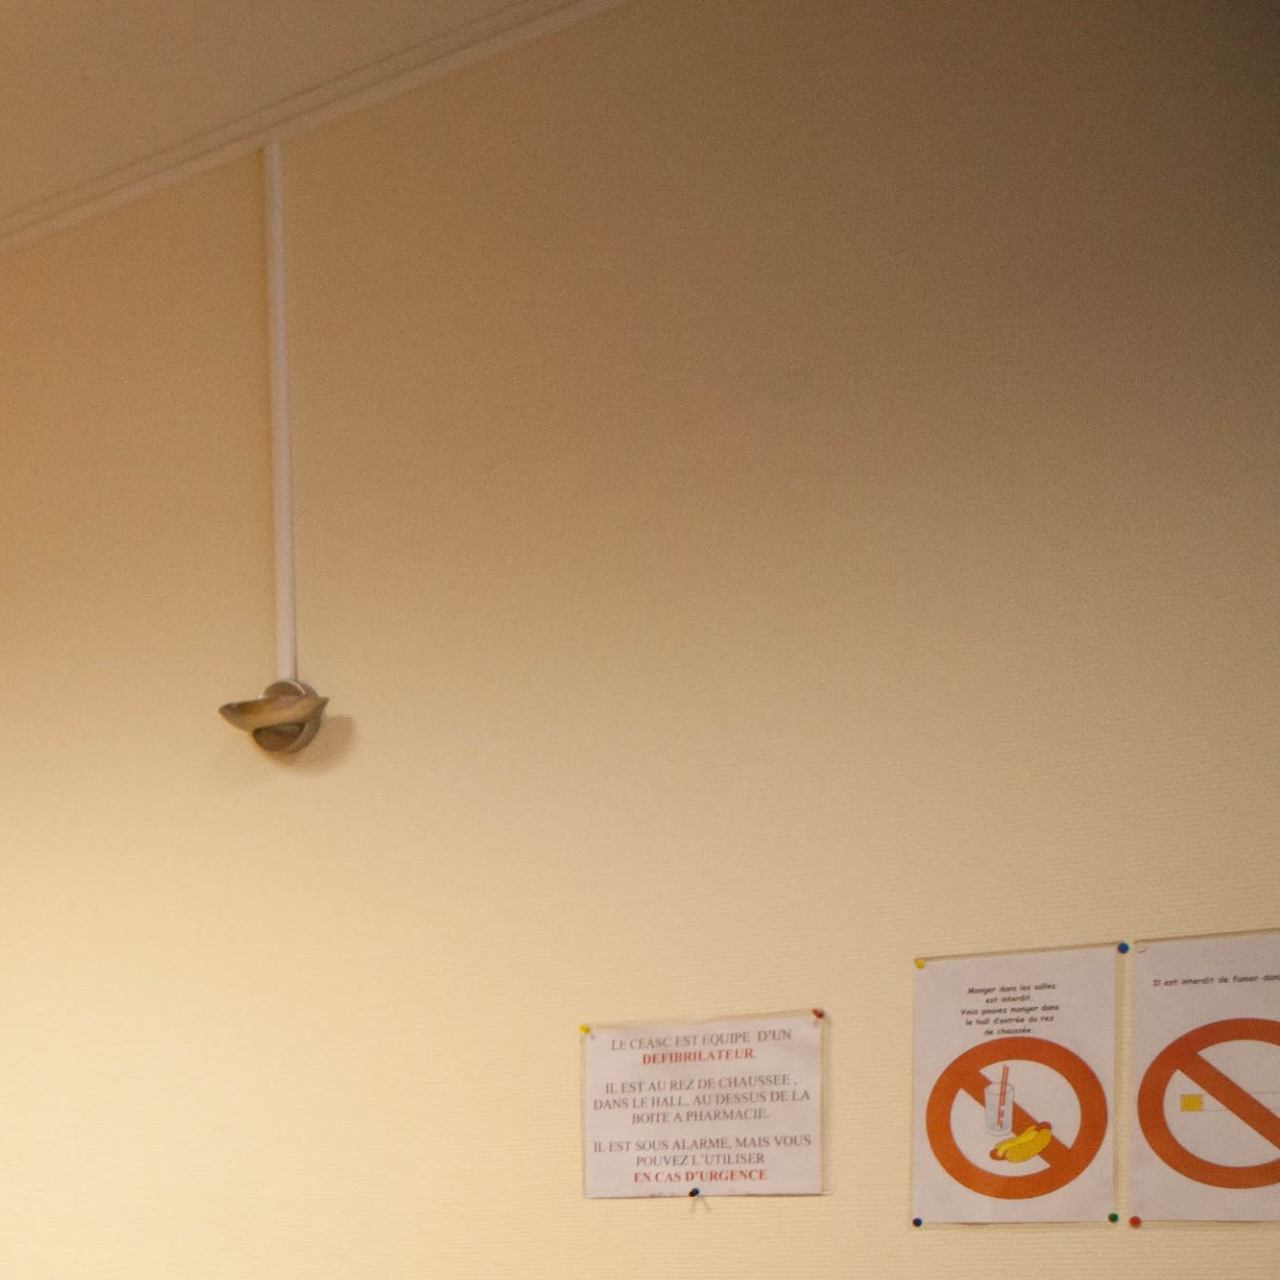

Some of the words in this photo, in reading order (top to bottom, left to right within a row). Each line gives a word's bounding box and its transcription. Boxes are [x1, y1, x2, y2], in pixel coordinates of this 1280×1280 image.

[968, 987, 996, 995] Manger
[999, 985, 1017, 993] dans
[1019, 983, 1031, 991] les
[1034, 982, 1056, 991] salles
[1164, 979, 1178, 987] est
[1218, 975, 1228, 984] de
[1233, 975, 1258, 983] fumer
[961, 1008, 978, 1016] Vous
[981, 1007, 1007, 1016] pouvez
[1010, 1005, 1039, 1014] manger
[975, 1017, 990, 1026] hall
[984, 1028, 994, 1036] de
[611, 1039, 627, 1051] LE
[629, 1037, 672, 1050] CEASC
[675, 1035, 699, 1048] EST
[702, 1031, 750, 1047] EQUIPE
[757, 1029, 792, 1042] D'UN
[606, 1082, 618, 1095] IL
[621, 1081, 644, 1094] EST
[647, 1079, 667, 1092] AU
[670, 1078, 694, 1091] REZ
[697, 1077, 715, 1090] DE
[593, 1097, 629, 1111] DANS
[632, 1096, 649, 1109] LE
[693, 1093, 713, 1107] AU
[715, 1091, 767, 1106] DESSUS
[770, 1090, 789, 1103] DE
[792, 1089, 810, 1102] LA
[632, 1111, 670, 1125] BOITE
[673, 1111, 683, 1123] A
[594, 1141, 605, 1153] IL
[608, 1140, 632, 1152] EST
[634, 1138, 669, 1151] SOUS
[735, 1135, 771, 1149] MAIS
[773, 1134, 812, 1147] VOUS
[636, 1154, 689, 1168] POUVEZ
[691, 1152, 766, 1167] L'UTILISER
[633, 1172, 650, 1184] EN
[655, 1170, 682, 1183] CAS
[684, 1168, 768, 1183] D'URGENCE
